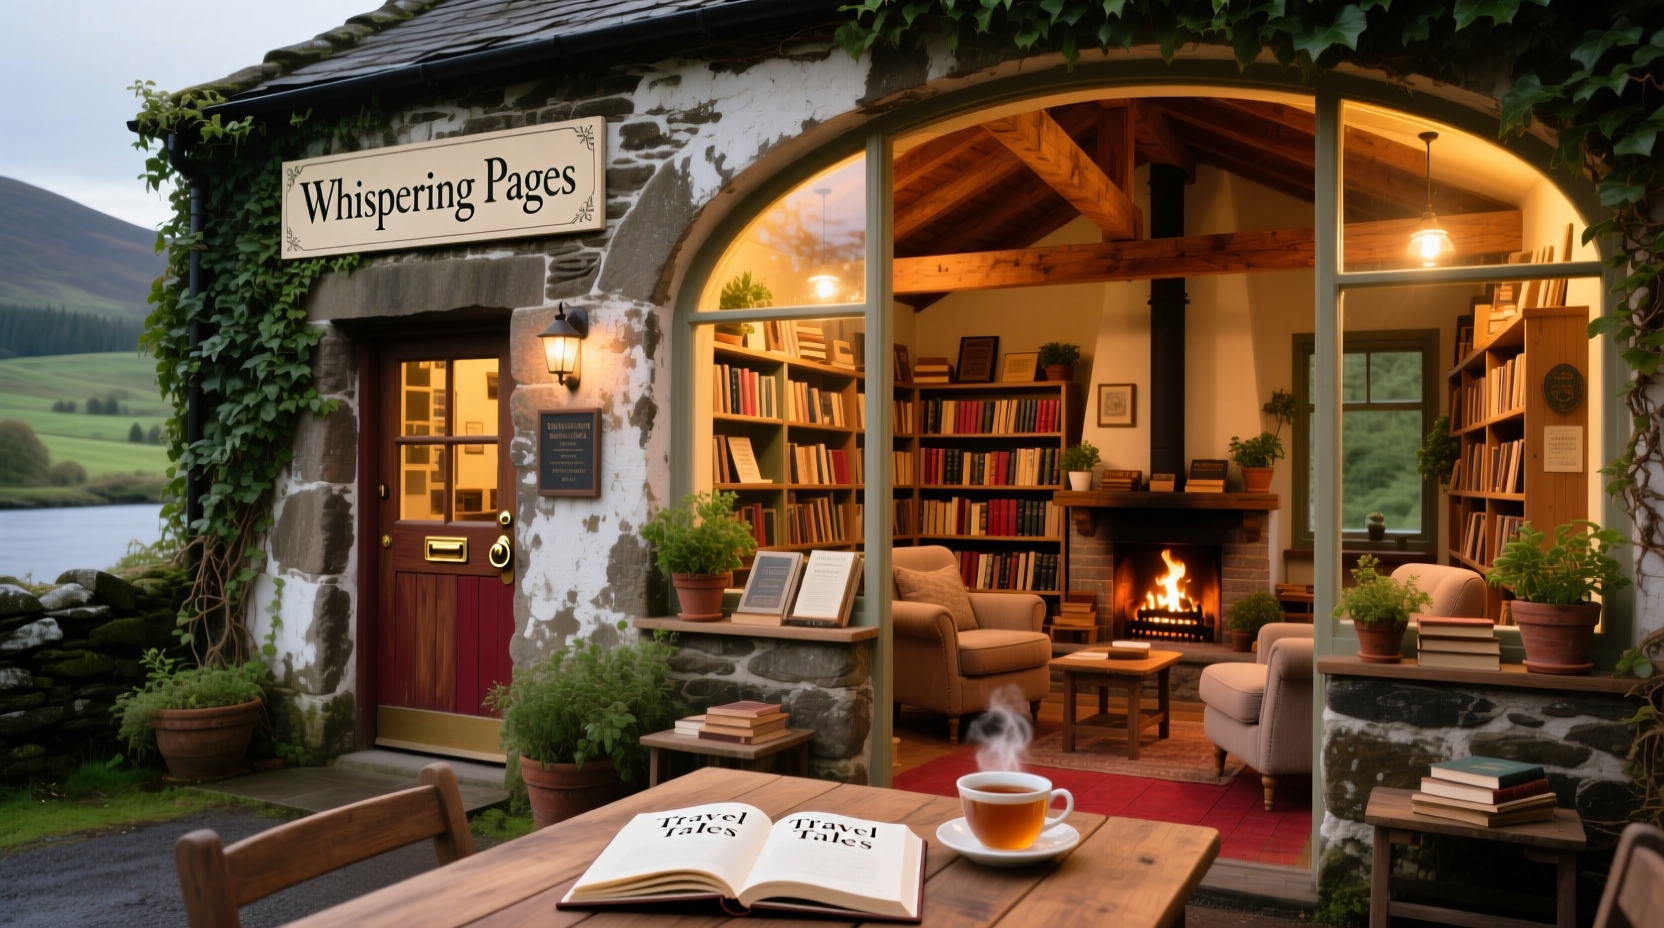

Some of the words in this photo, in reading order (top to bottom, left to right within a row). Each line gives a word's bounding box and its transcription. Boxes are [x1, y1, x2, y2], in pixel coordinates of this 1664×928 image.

[300, 172, 475, 231] Whispering
[484, 157, 576, 214] Pages
[657, 812, 748, 829] Travel
[663, 822, 738, 838] Tales
[789, 818, 877, 838] Travel
[793, 829, 872, 850] Tales
